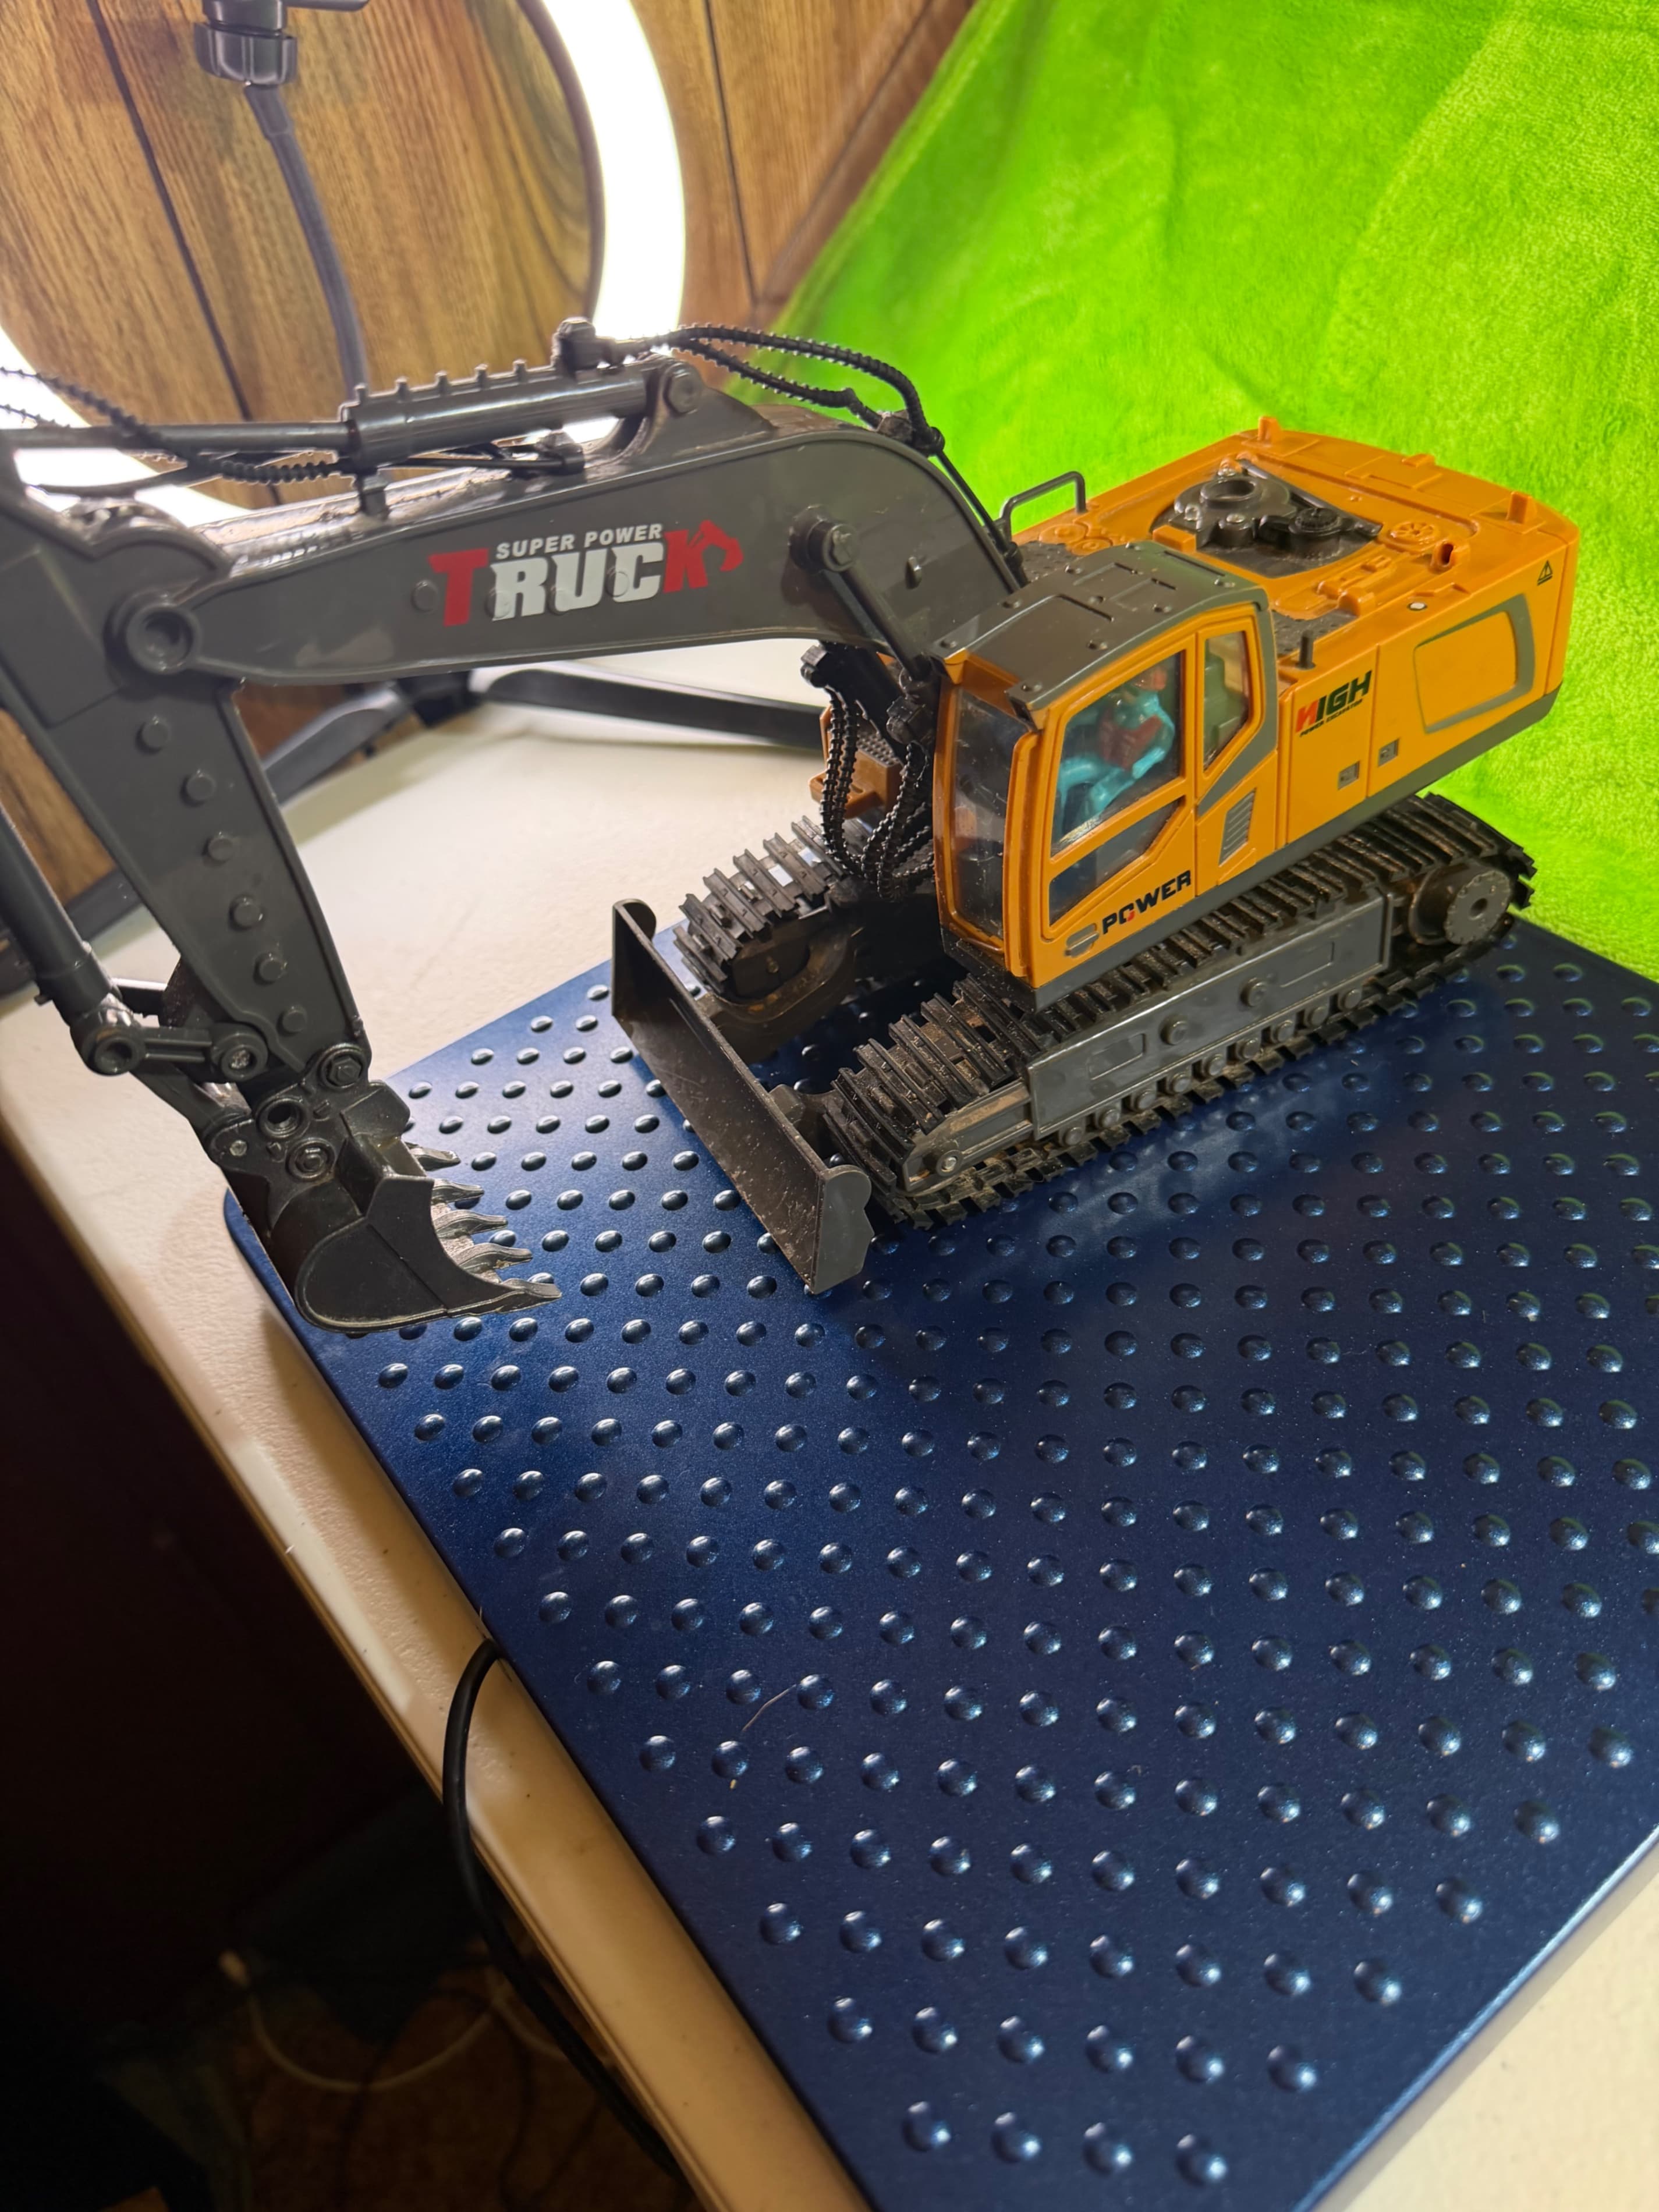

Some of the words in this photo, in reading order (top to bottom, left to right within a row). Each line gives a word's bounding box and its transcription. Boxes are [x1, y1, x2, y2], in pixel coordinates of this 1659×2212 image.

[427, 519, 744, 627] TRUCK
[495, 534, 575, 559] SUPER
[584, 523, 662, 548] POWER
[1101, 870, 1192, 935] POWER
